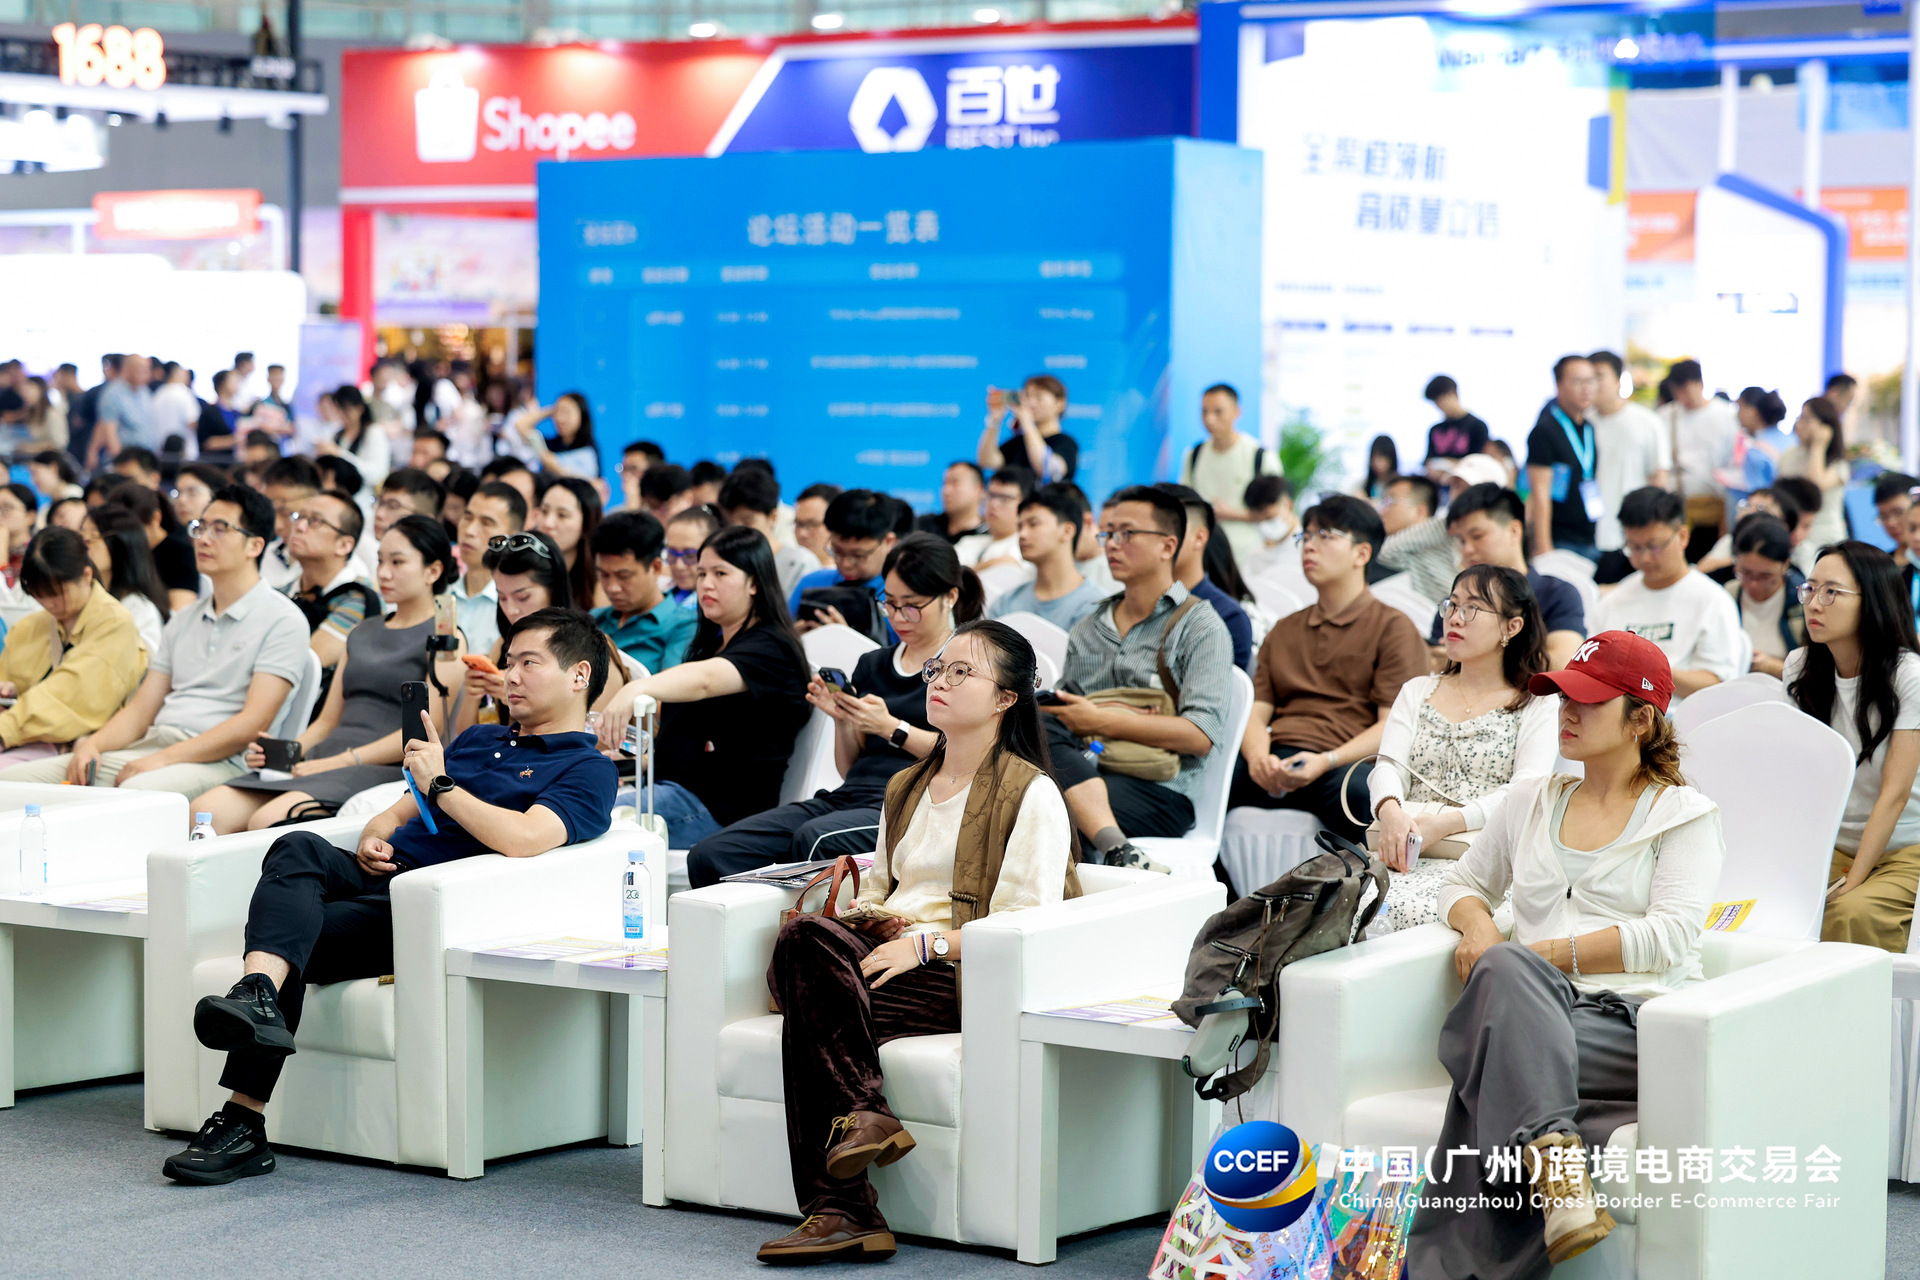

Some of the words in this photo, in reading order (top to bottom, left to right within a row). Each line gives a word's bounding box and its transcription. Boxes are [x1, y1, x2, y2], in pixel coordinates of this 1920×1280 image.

[52, 22, 167, 90] 1688
[946, 65, 1061, 126] 百世
[482, 97, 637, 163] Shopee
